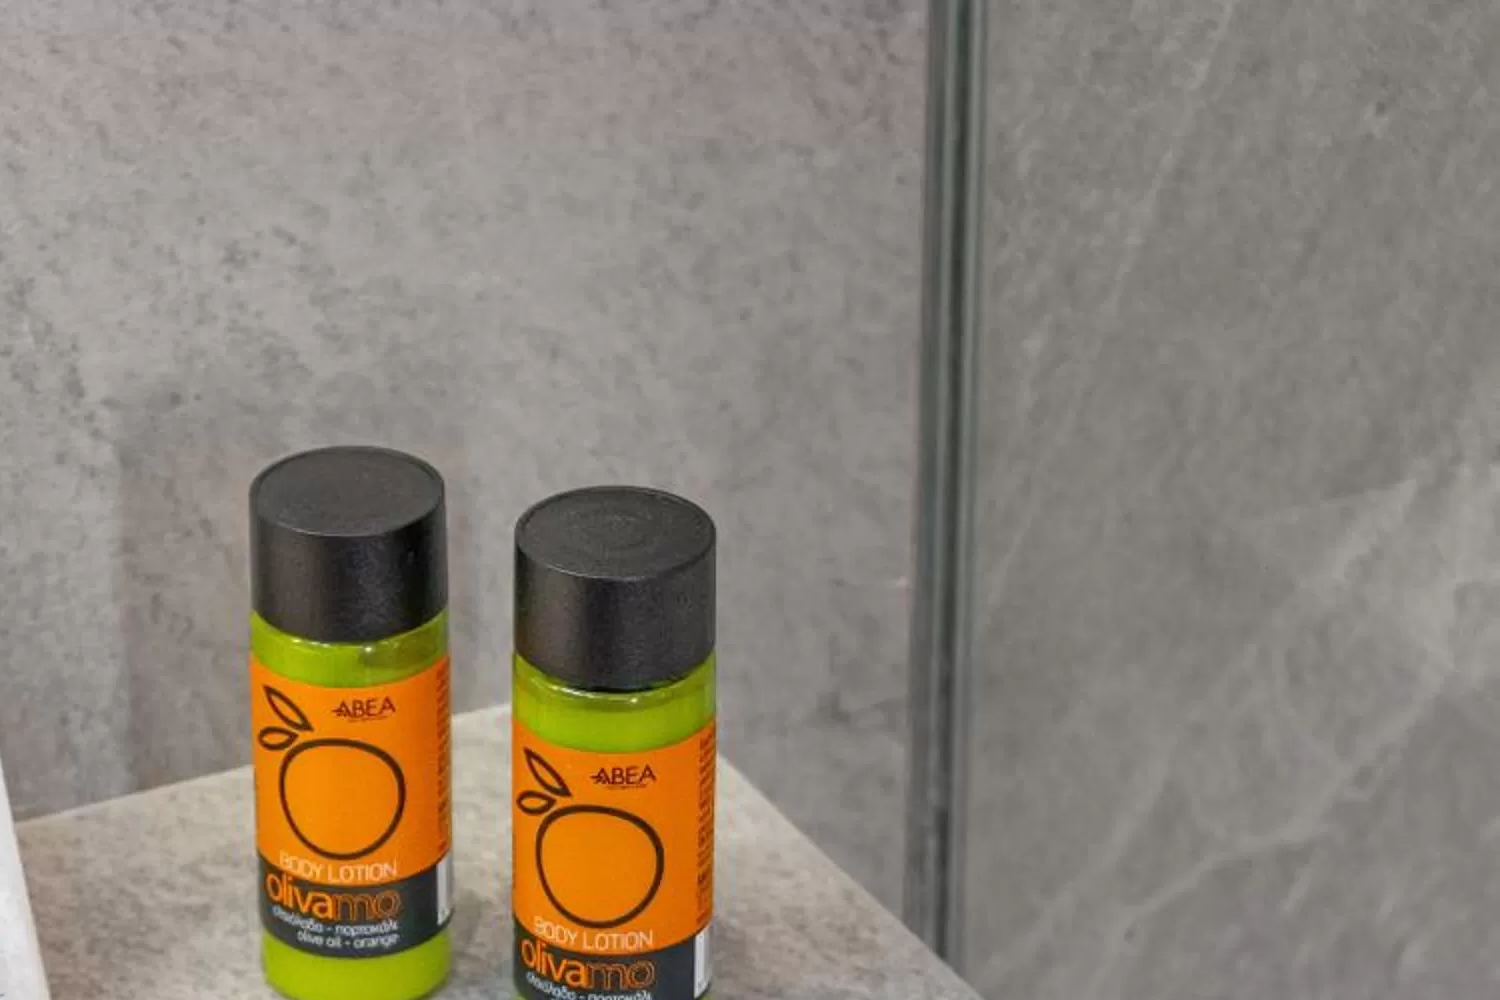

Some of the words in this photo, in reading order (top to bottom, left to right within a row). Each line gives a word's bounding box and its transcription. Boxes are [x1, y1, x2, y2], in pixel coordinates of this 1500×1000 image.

[280, 850, 323, 881] BODY
[327, 857, 398, 882] LOTION
[265, 872, 404, 921] olivamo
[296, 931, 324, 946] olive
[326, 935, 343, 949] oil
[353, 933, 400, 949] orange
[533, 916, 578, 946] BODY
[582, 930, 653, 951] LOTION
[521, 938, 656, 991] olivamo
